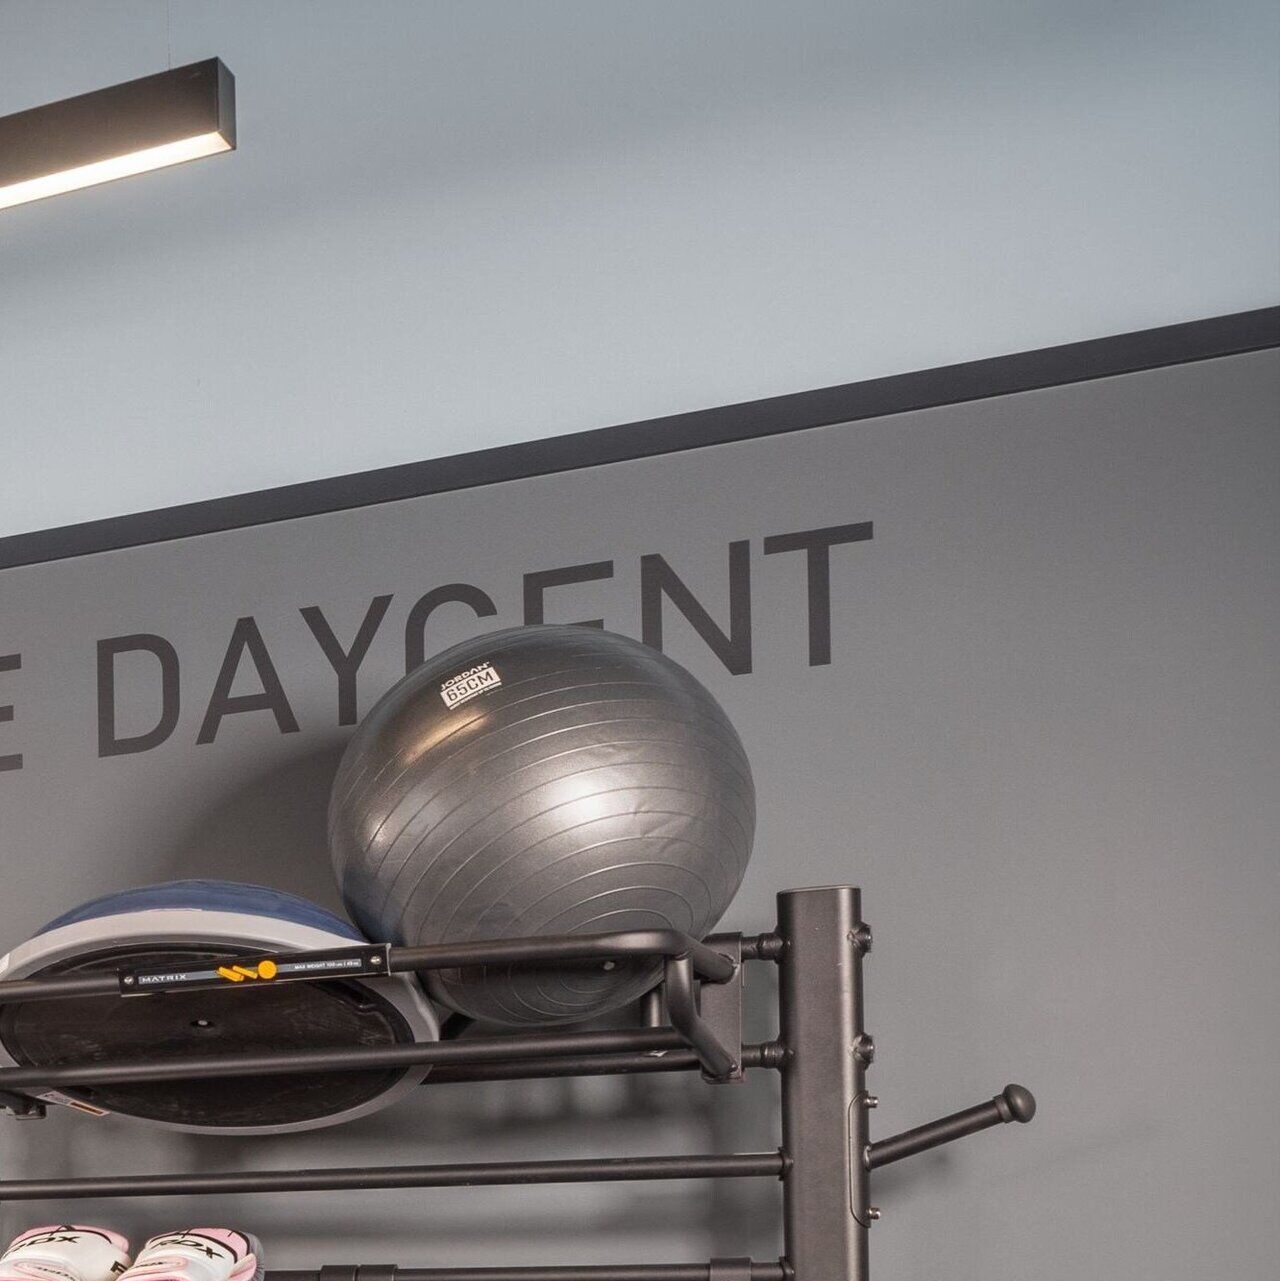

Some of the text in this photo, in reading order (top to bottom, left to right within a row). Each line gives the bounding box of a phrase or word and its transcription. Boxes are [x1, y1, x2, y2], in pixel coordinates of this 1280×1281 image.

[441, 661, 490, 691] JORDAN
[446, 671, 494, 702] 65CM
[142, 973, 187, 983] MATRIX
